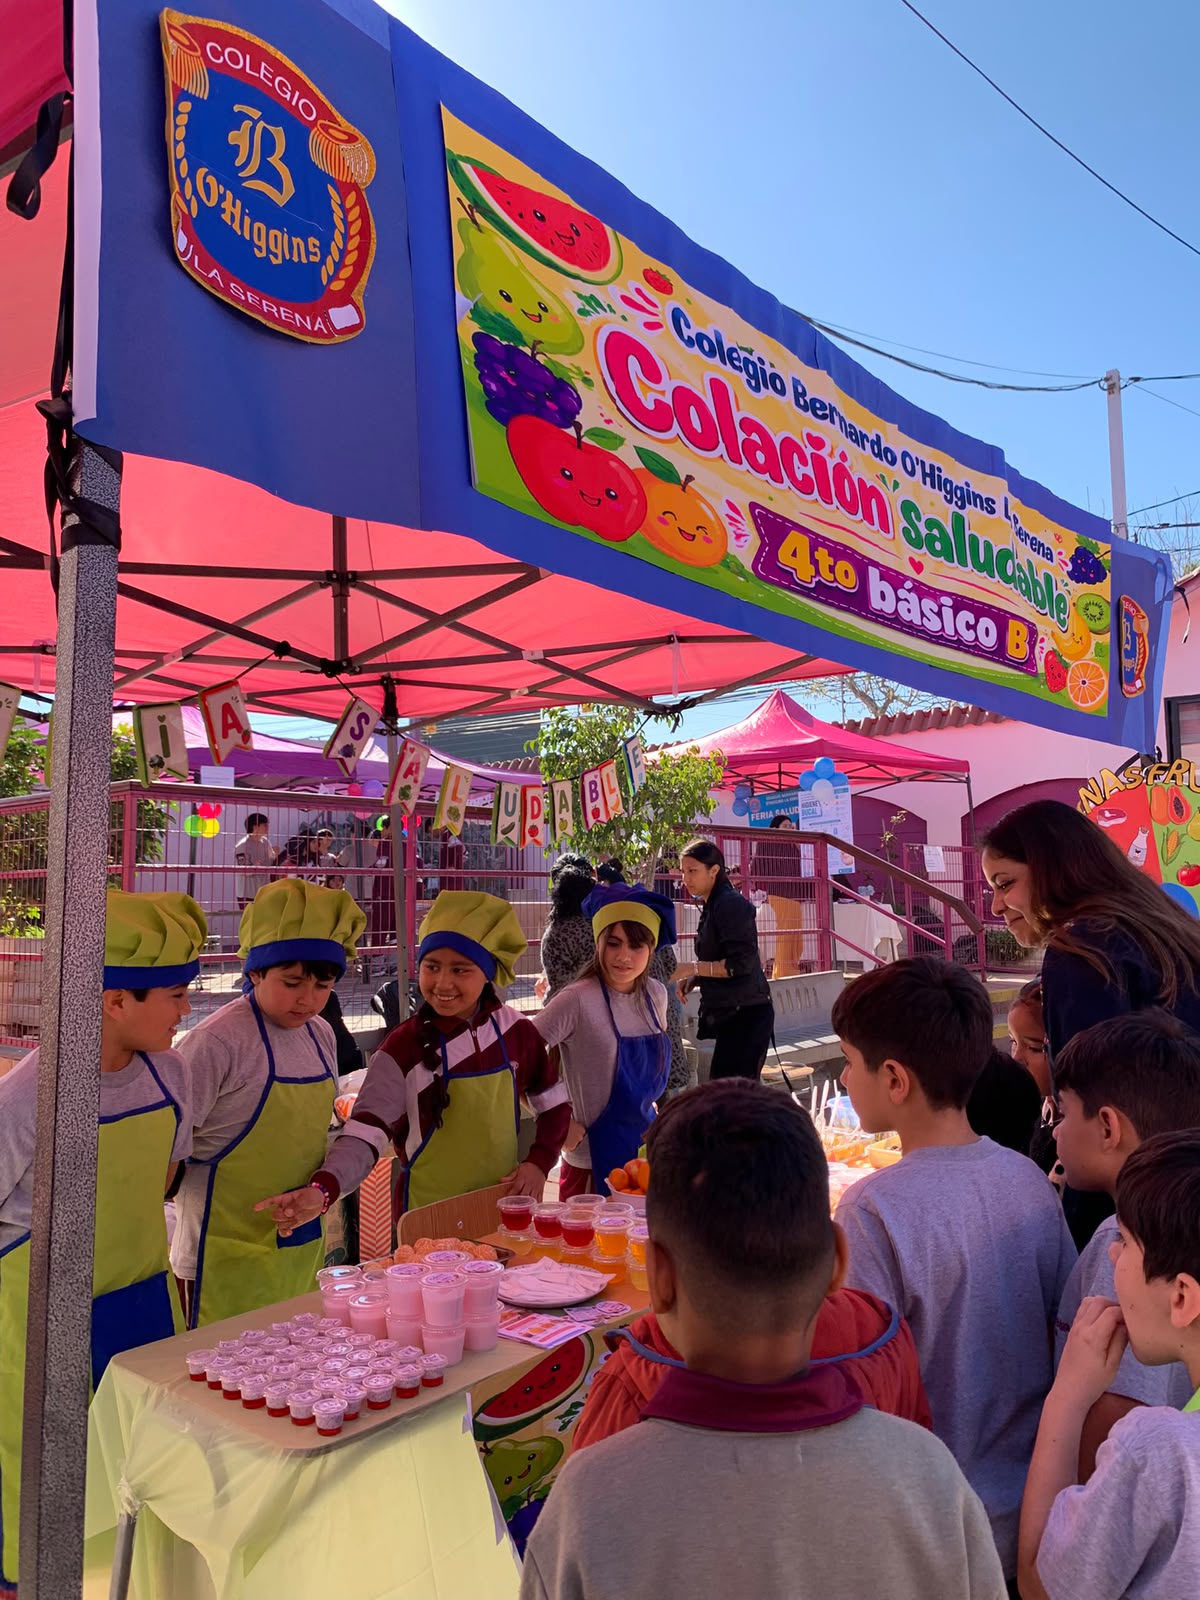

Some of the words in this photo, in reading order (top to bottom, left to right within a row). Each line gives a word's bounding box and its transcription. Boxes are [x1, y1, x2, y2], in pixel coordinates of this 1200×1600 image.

[205, 41, 318, 122] COLEGIO
[227, 103, 296, 208] B
[195, 167, 321, 266] O'Higgins
[193, 254, 225, 288] LA
[229, 282, 329, 335] SERENA
[603, 329, 892, 536] Colación
[670, 306, 787, 394] Colegio
[791, 375, 898, 468] Bernardo
[901, 453, 997, 516] O'Higgins
[777, 529, 858, 590] 4to
[868, 569, 998, 648] básico
[1006, 619, 1029, 661] B
[899, 498, 1068, 629] Saludable
[751, 810, 774, 821] FERIA
[1078, 767, 1144, 815] NAS
